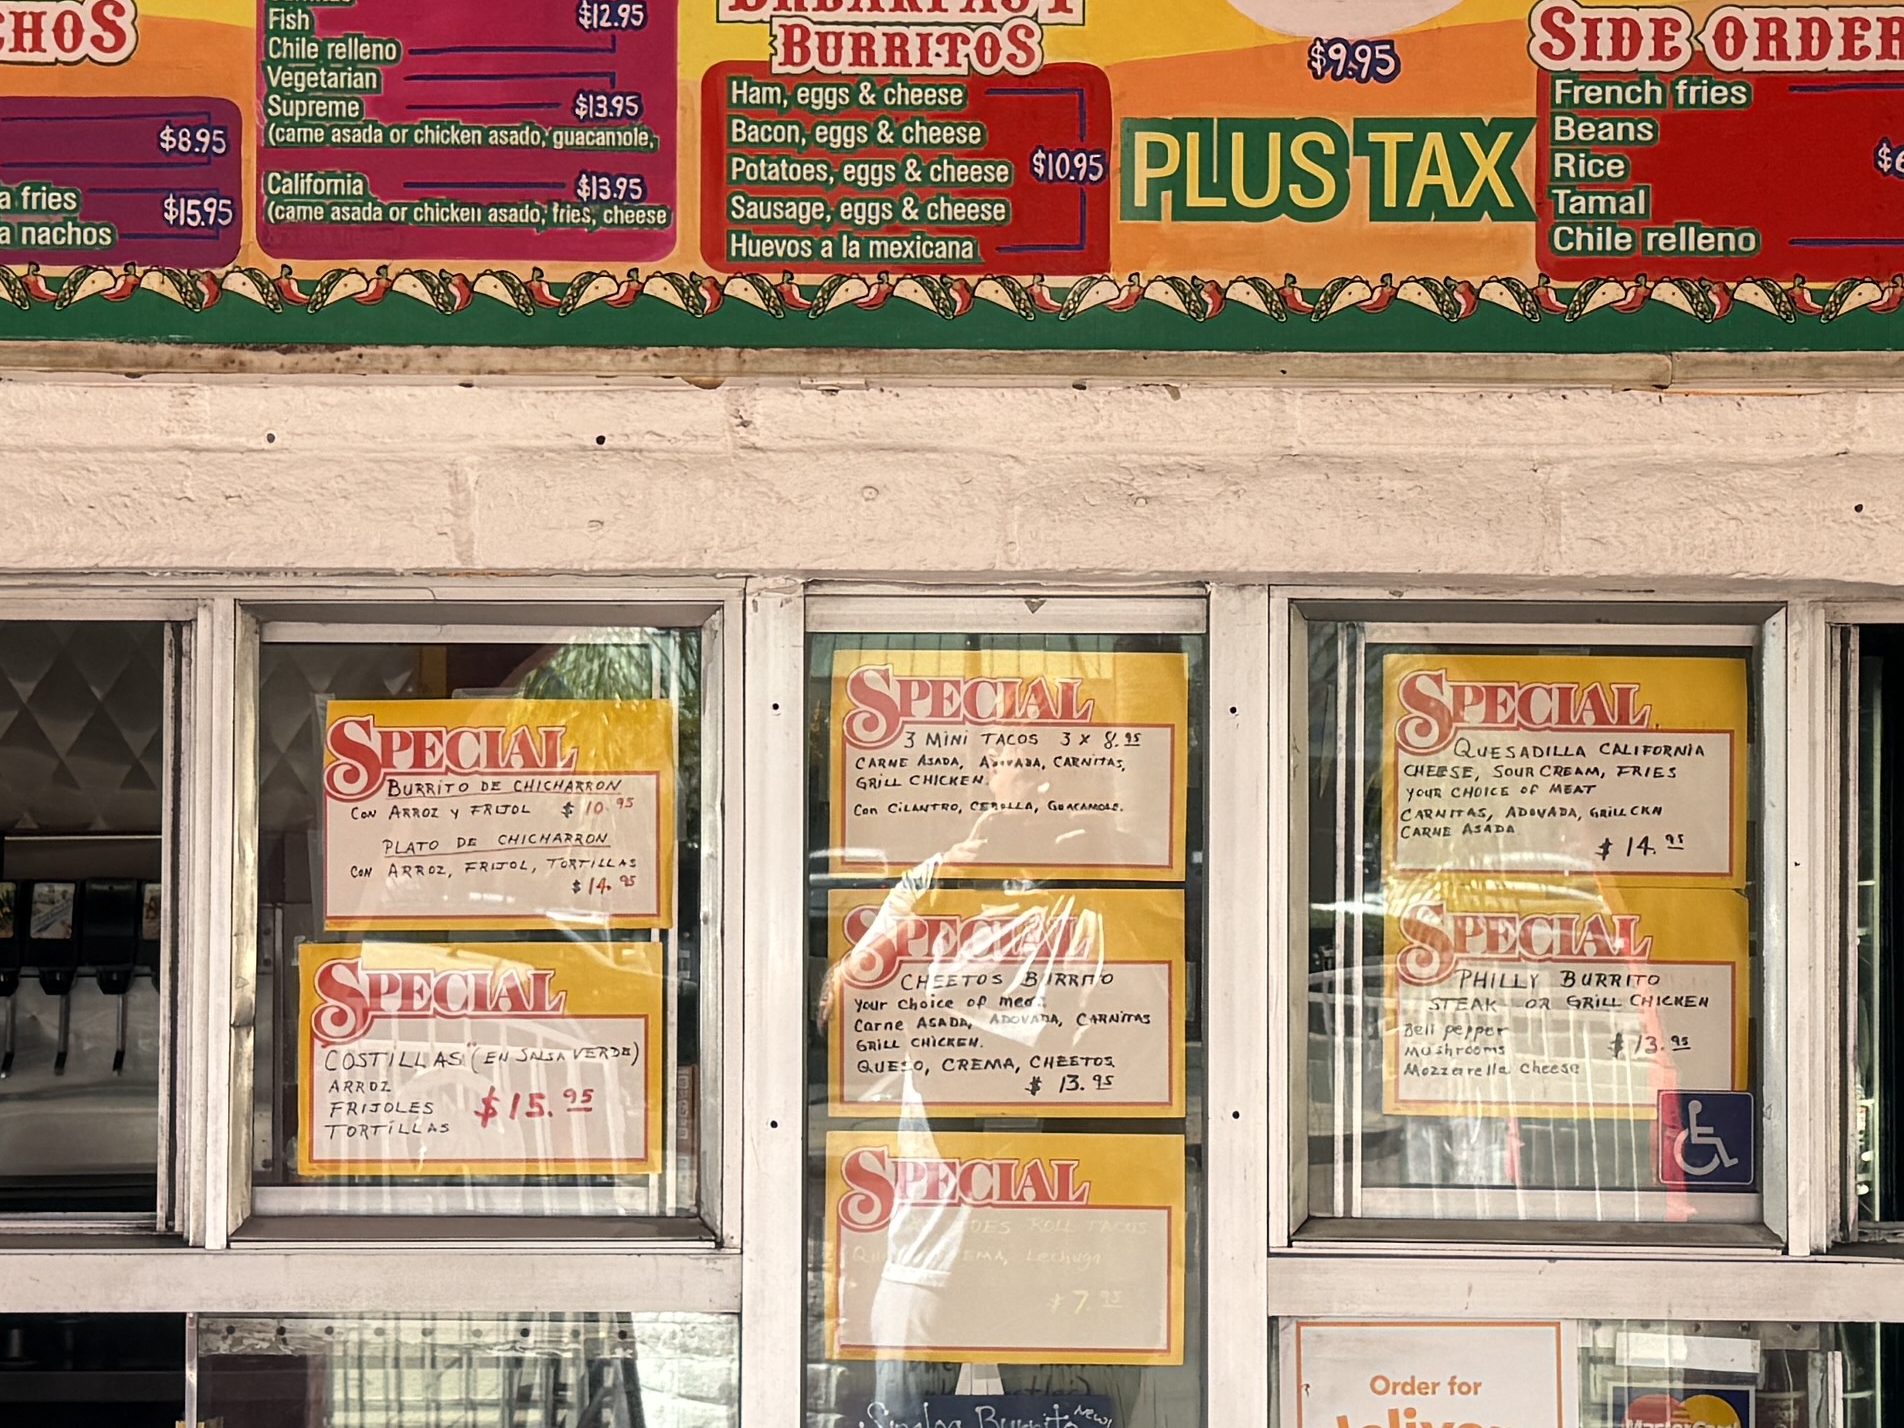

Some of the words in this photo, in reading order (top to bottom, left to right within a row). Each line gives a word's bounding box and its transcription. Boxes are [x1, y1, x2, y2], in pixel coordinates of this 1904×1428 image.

[781, 24, 1037, 69] BURRITOS
[1540, 8, 1681, 60] SIDE
[268, 40, 320, 60] Chile
[328, 40, 396, 60] relleno
[1310, 42, 1396, 83] $9.95
[1555, 81, 1661, 105] French
[1677, 81, 1748, 105] fries
[268, 97, 358, 121] Supreme
[576, 94, 639, 119] $13.95
[1137, 130, 1334, 209] PLUS
[1368, 130, 1514, 209] TAX
[1553, 192, 1645, 214] Tamal
[844, 665, 1094, 749] SPECIAL
[1397, 669, 1651, 754] SPECIAL
[326, 716, 580, 798] SPECIAL
[1455, 738, 1585, 759] QUESADILLA
[481, 781, 501, 792] DE
[1457, 969, 1542, 990] PHILLY
[1560, 970, 1660, 988] BURRITO
[313, 958, 567, 1044] SPECIAL
[329, 1101, 433, 1116] FRIJOLES
[1369, 1374, 1439, 1396] Order
[1449, 1375, 1482, 1396] for
